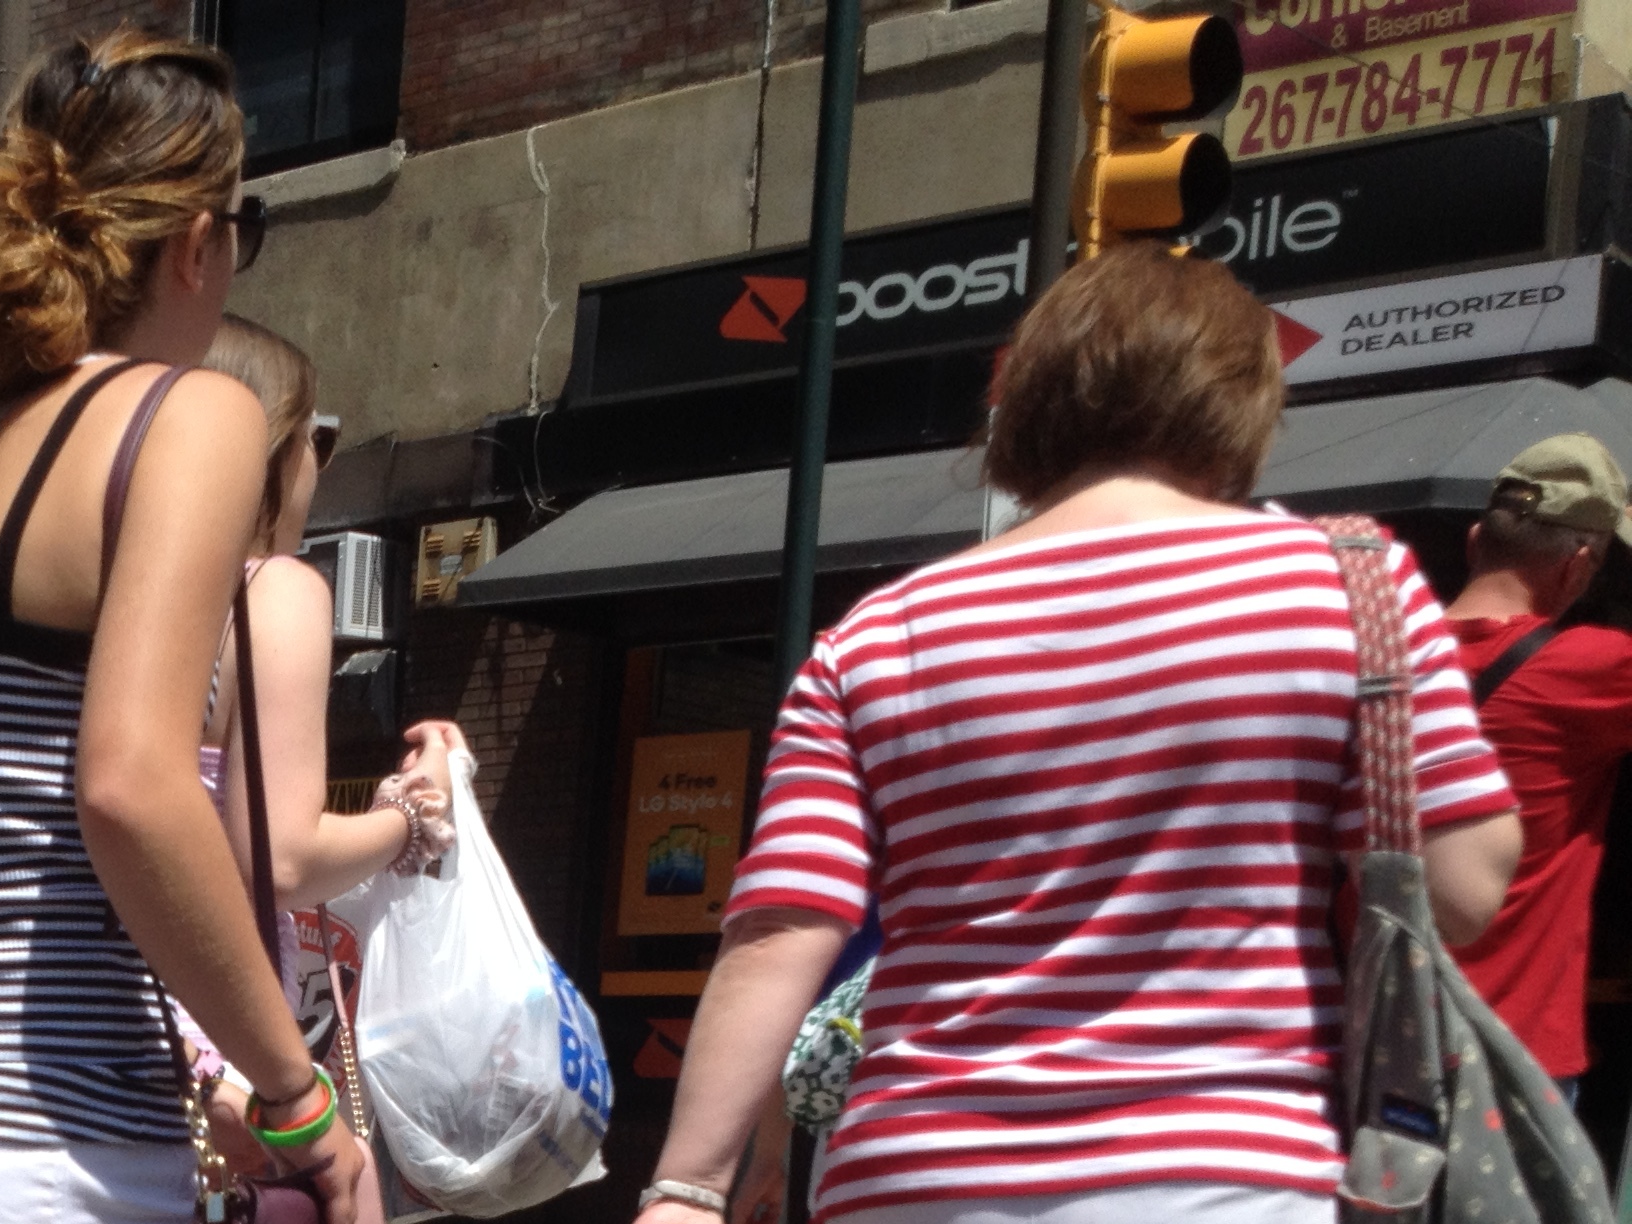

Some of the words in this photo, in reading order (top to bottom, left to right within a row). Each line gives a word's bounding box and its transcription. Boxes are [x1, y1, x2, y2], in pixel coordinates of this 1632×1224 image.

[1330, 25, 1347, 48] &
[1365, 3, 1469, 42] Basement
[1237, 28, 1557, 156] 267-784-7771
[1343, 282, 1566, 333] AUTHORIZED
[1340, 319, 1475, 357] DEALER
[674, 773, 717, 790] Free
[639, 796, 665, 813] LG
